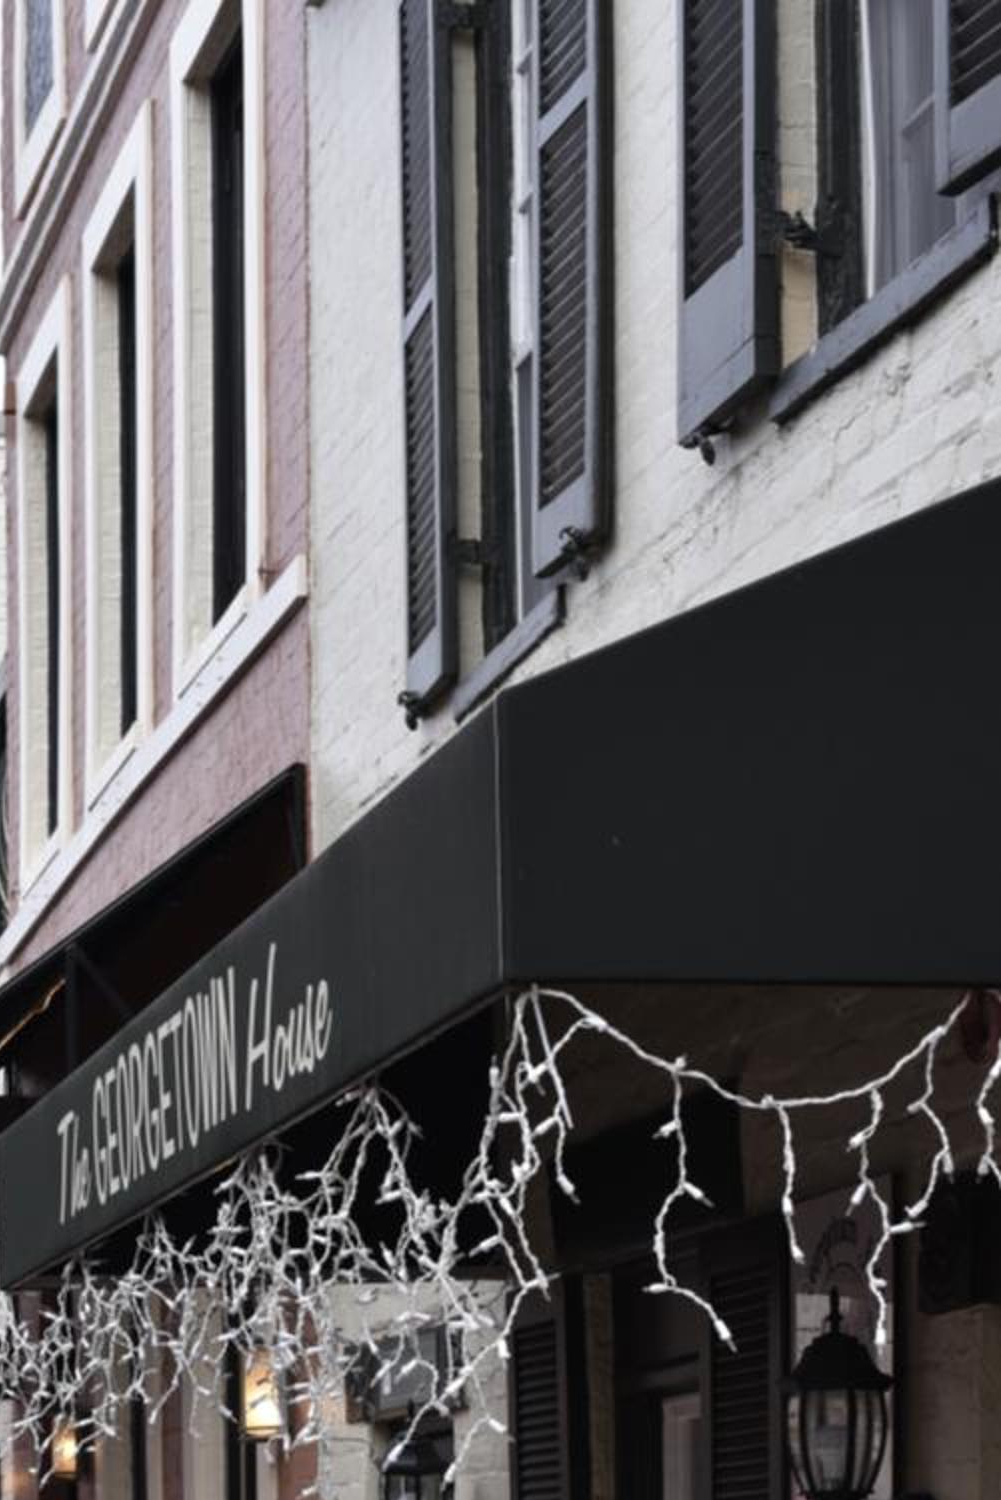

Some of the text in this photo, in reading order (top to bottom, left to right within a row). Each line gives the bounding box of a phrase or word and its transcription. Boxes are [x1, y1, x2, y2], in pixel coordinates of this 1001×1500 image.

[58, 942, 333, 1225] The GEORGETOWN House
